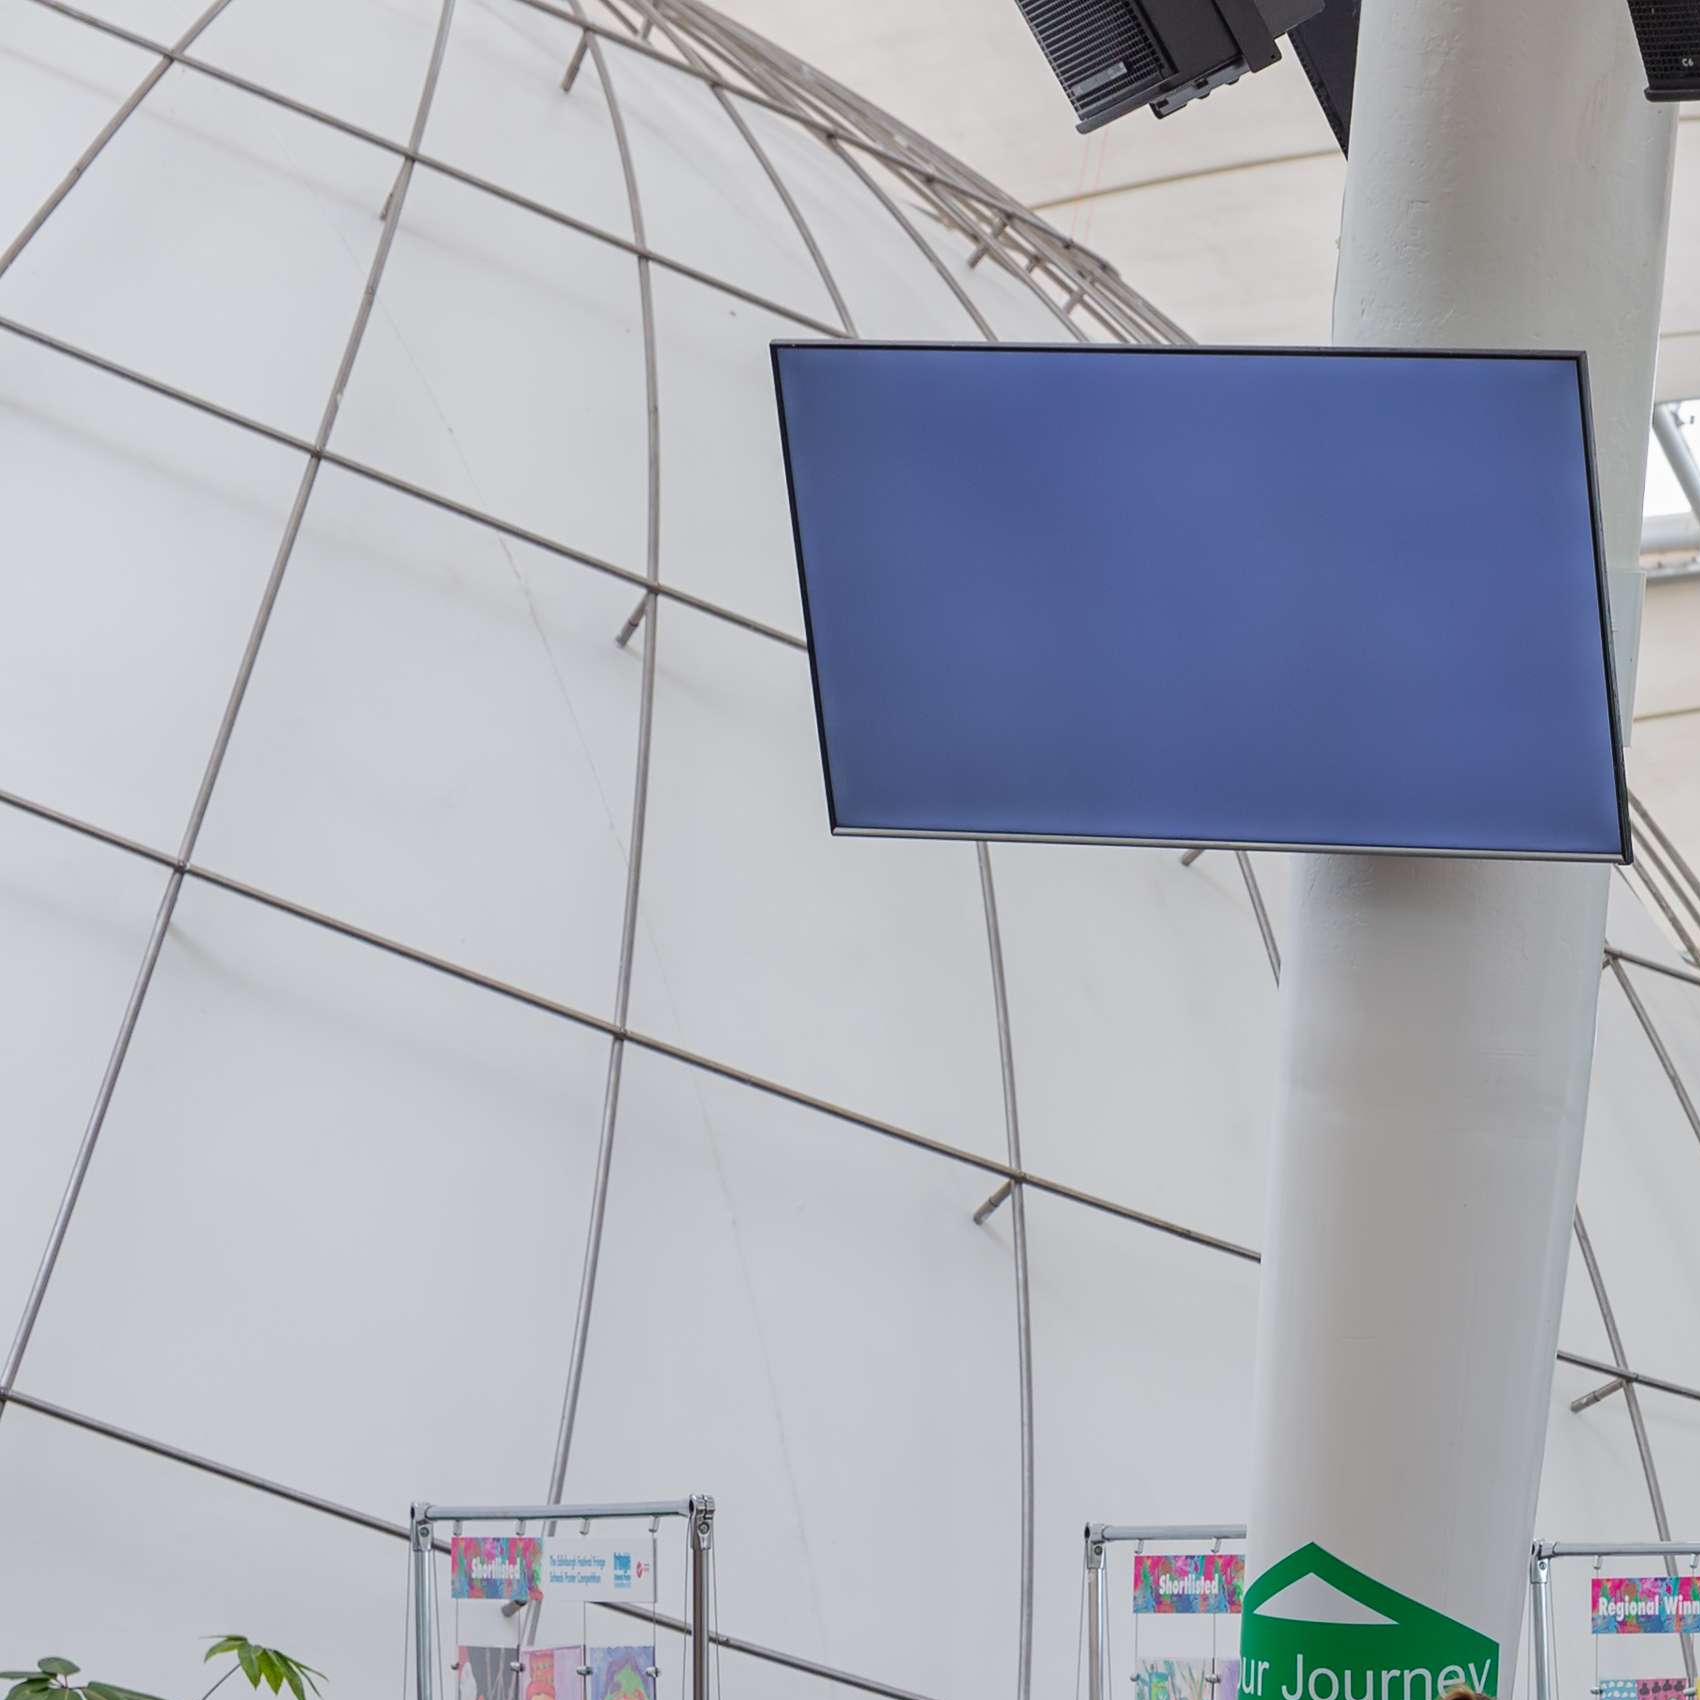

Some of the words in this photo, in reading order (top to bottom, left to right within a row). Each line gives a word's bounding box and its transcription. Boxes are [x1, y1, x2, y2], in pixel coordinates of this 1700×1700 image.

[1681, 57, 1694, 67] C6
[471, 1556, 521, 1579] Shortlisted
[1159, 1573, 1219, 1595] Shortlisted
[1598, 1594, 1659, 1621] Regional
[1237, 1656, 1270, 1697] ur
